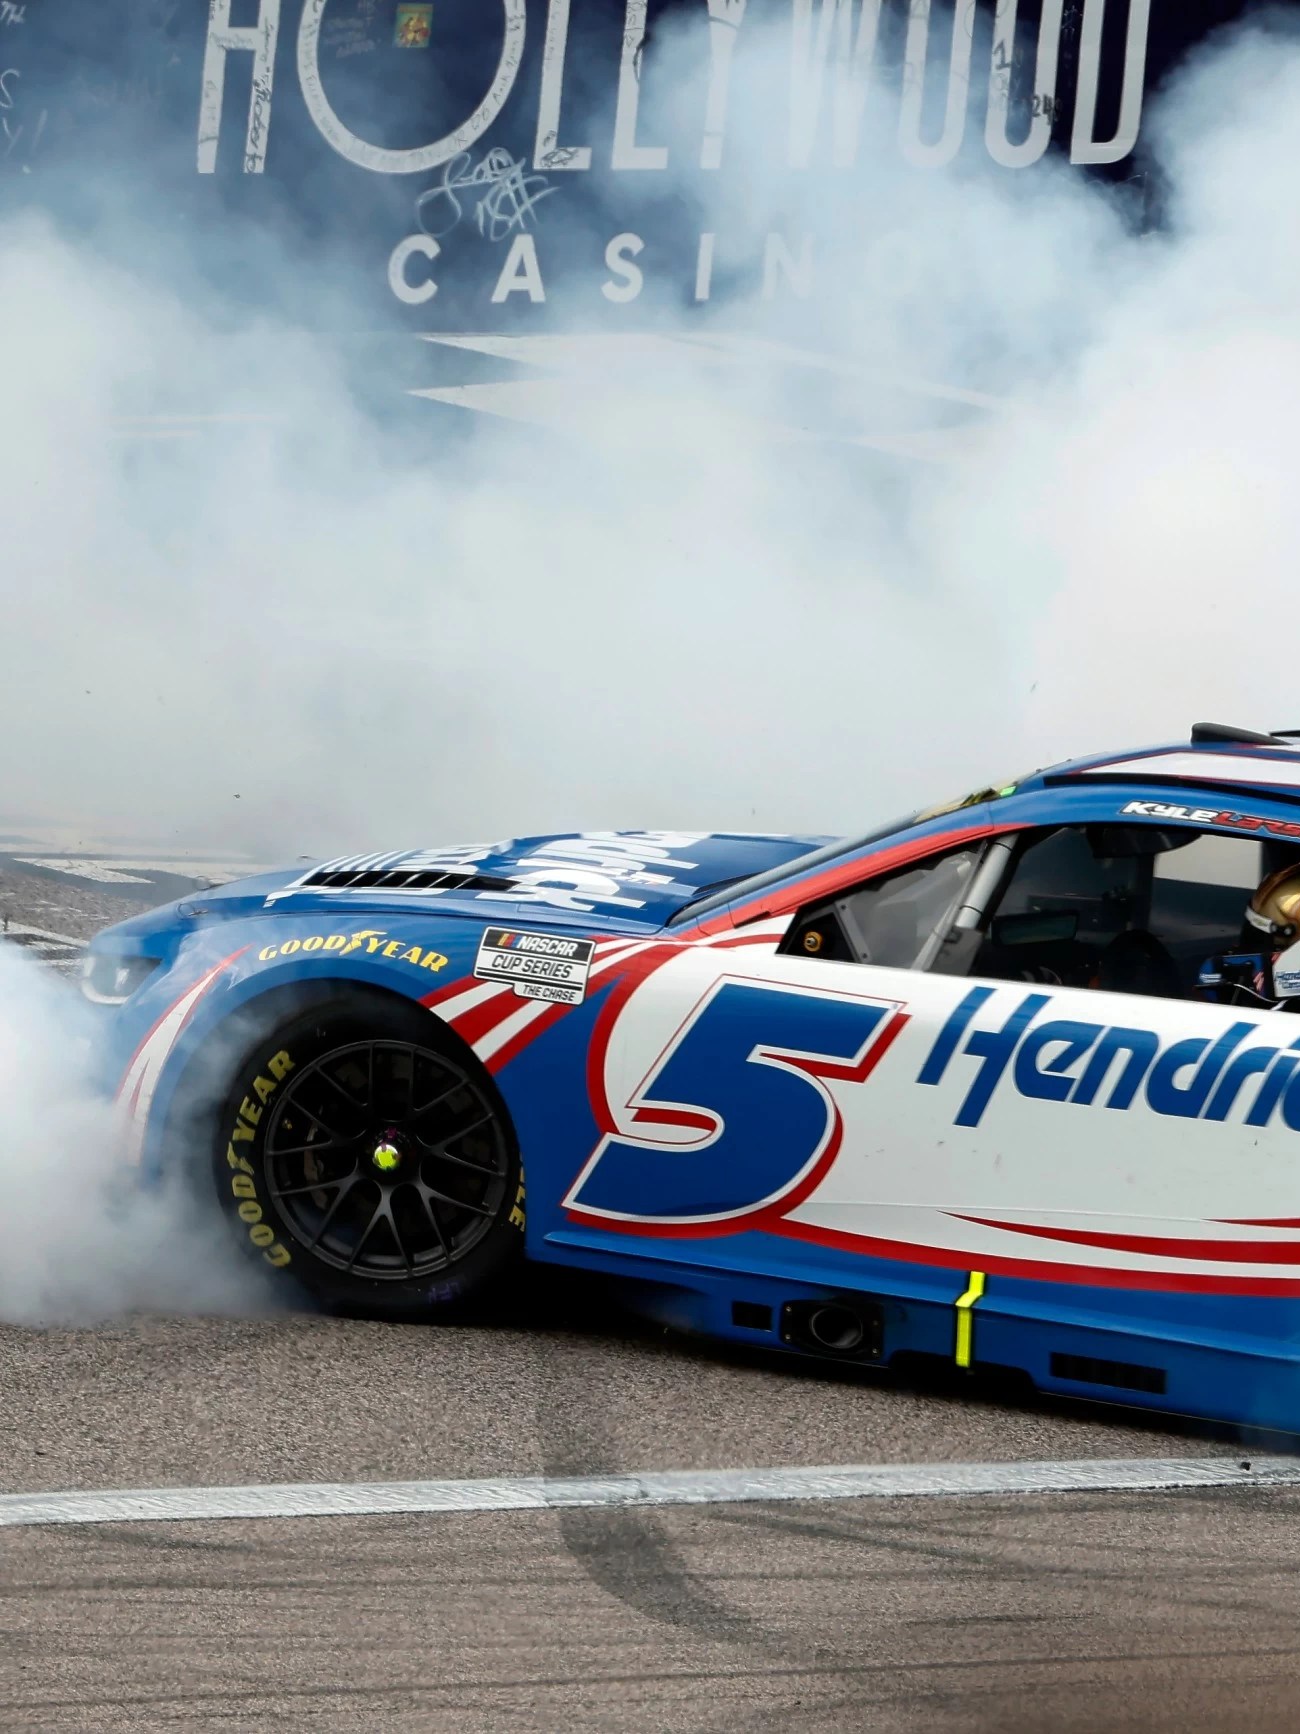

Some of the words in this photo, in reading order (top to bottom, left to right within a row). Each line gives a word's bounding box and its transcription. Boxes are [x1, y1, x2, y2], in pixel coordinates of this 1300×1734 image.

[388, 229, 922, 304] CASIN
[258, 930, 449, 974] GOODYEAR
[491, 954, 521, 971] CUP
[521, 958, 573, 979] SERIES
[516, 935, 579, 958] NASCAR
[522, 984, 542, 997] THE
[542, 987, 576, 1002] CHASE
[561, 973, 912, 1239] 5
[227, 1050, 297, 1268] GOODYEAR
